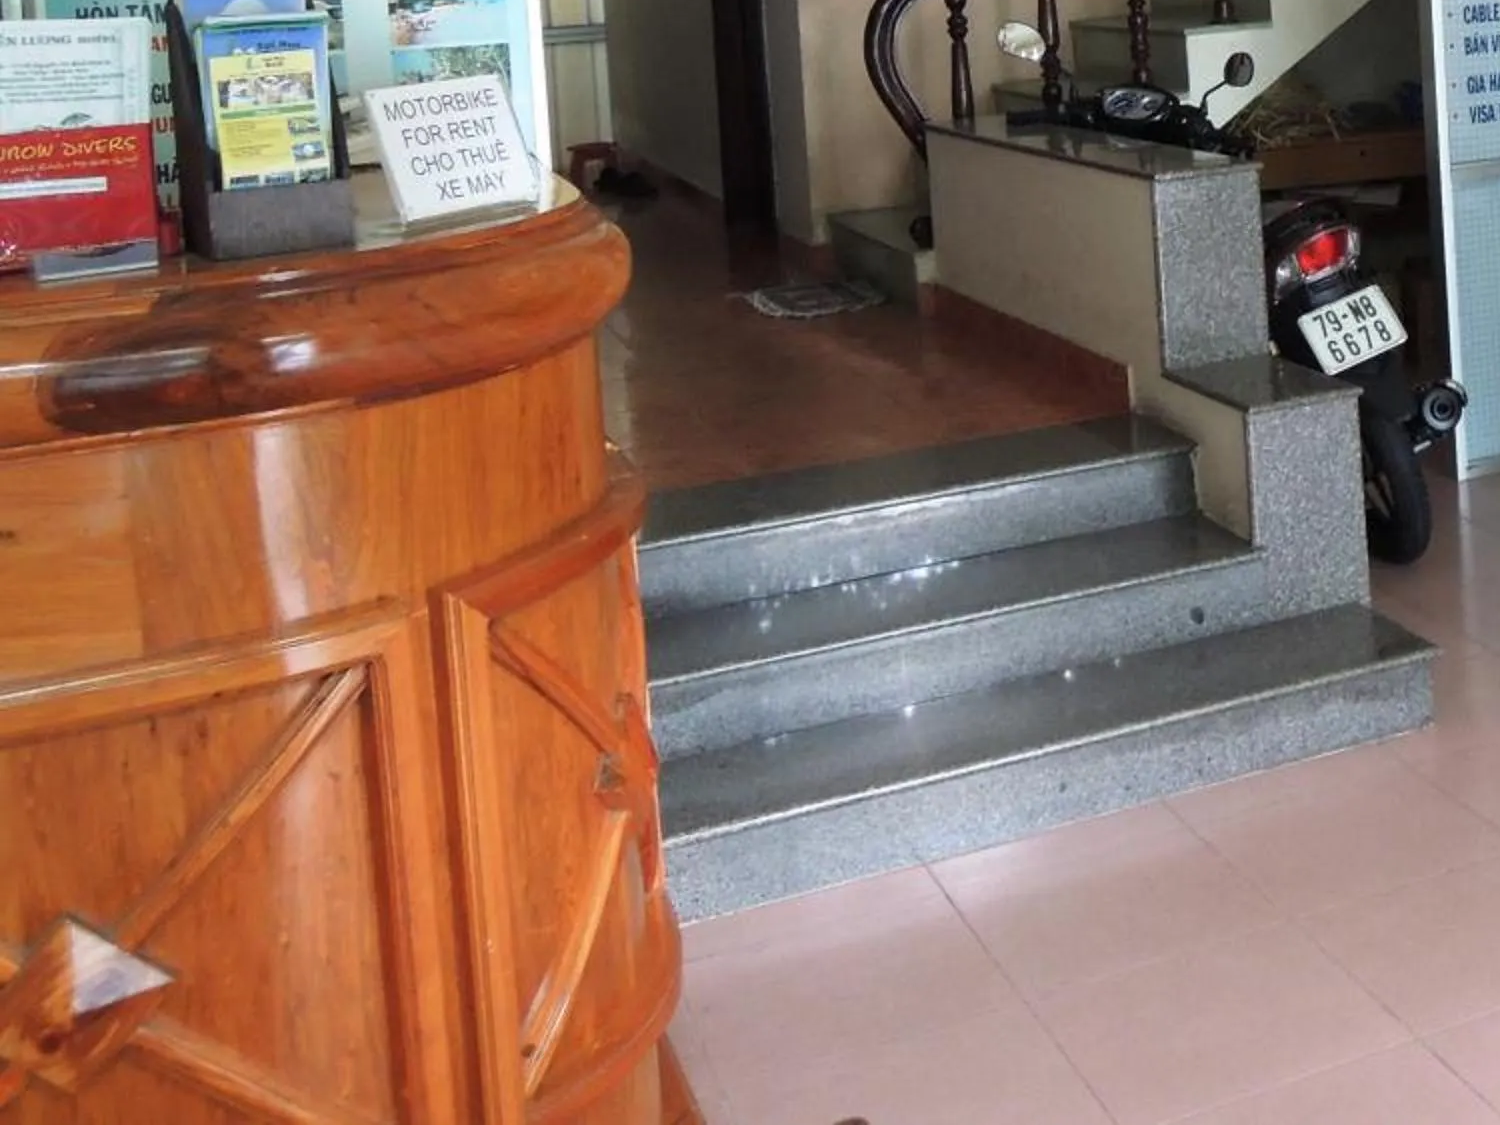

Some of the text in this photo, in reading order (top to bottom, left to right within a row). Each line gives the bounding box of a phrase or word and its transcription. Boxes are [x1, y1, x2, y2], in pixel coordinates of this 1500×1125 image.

[1463, 3, 1500, 24] CABLE
[1467, 74, 1486, 94] GIA
[384, 87, 498, 122] MOTORBIKE
[1469, 102, 1497, 123] VISA
[401, 116, 497, 148] FOR RENT
[63, 136, 138, 159] DIVERS
[411, 151, 455, 176] CHO
[436, 178, 465, 201] XE
[1312, 294, 1378, 338] 79-N8
[1327, 320, 1392, 364] 6678
